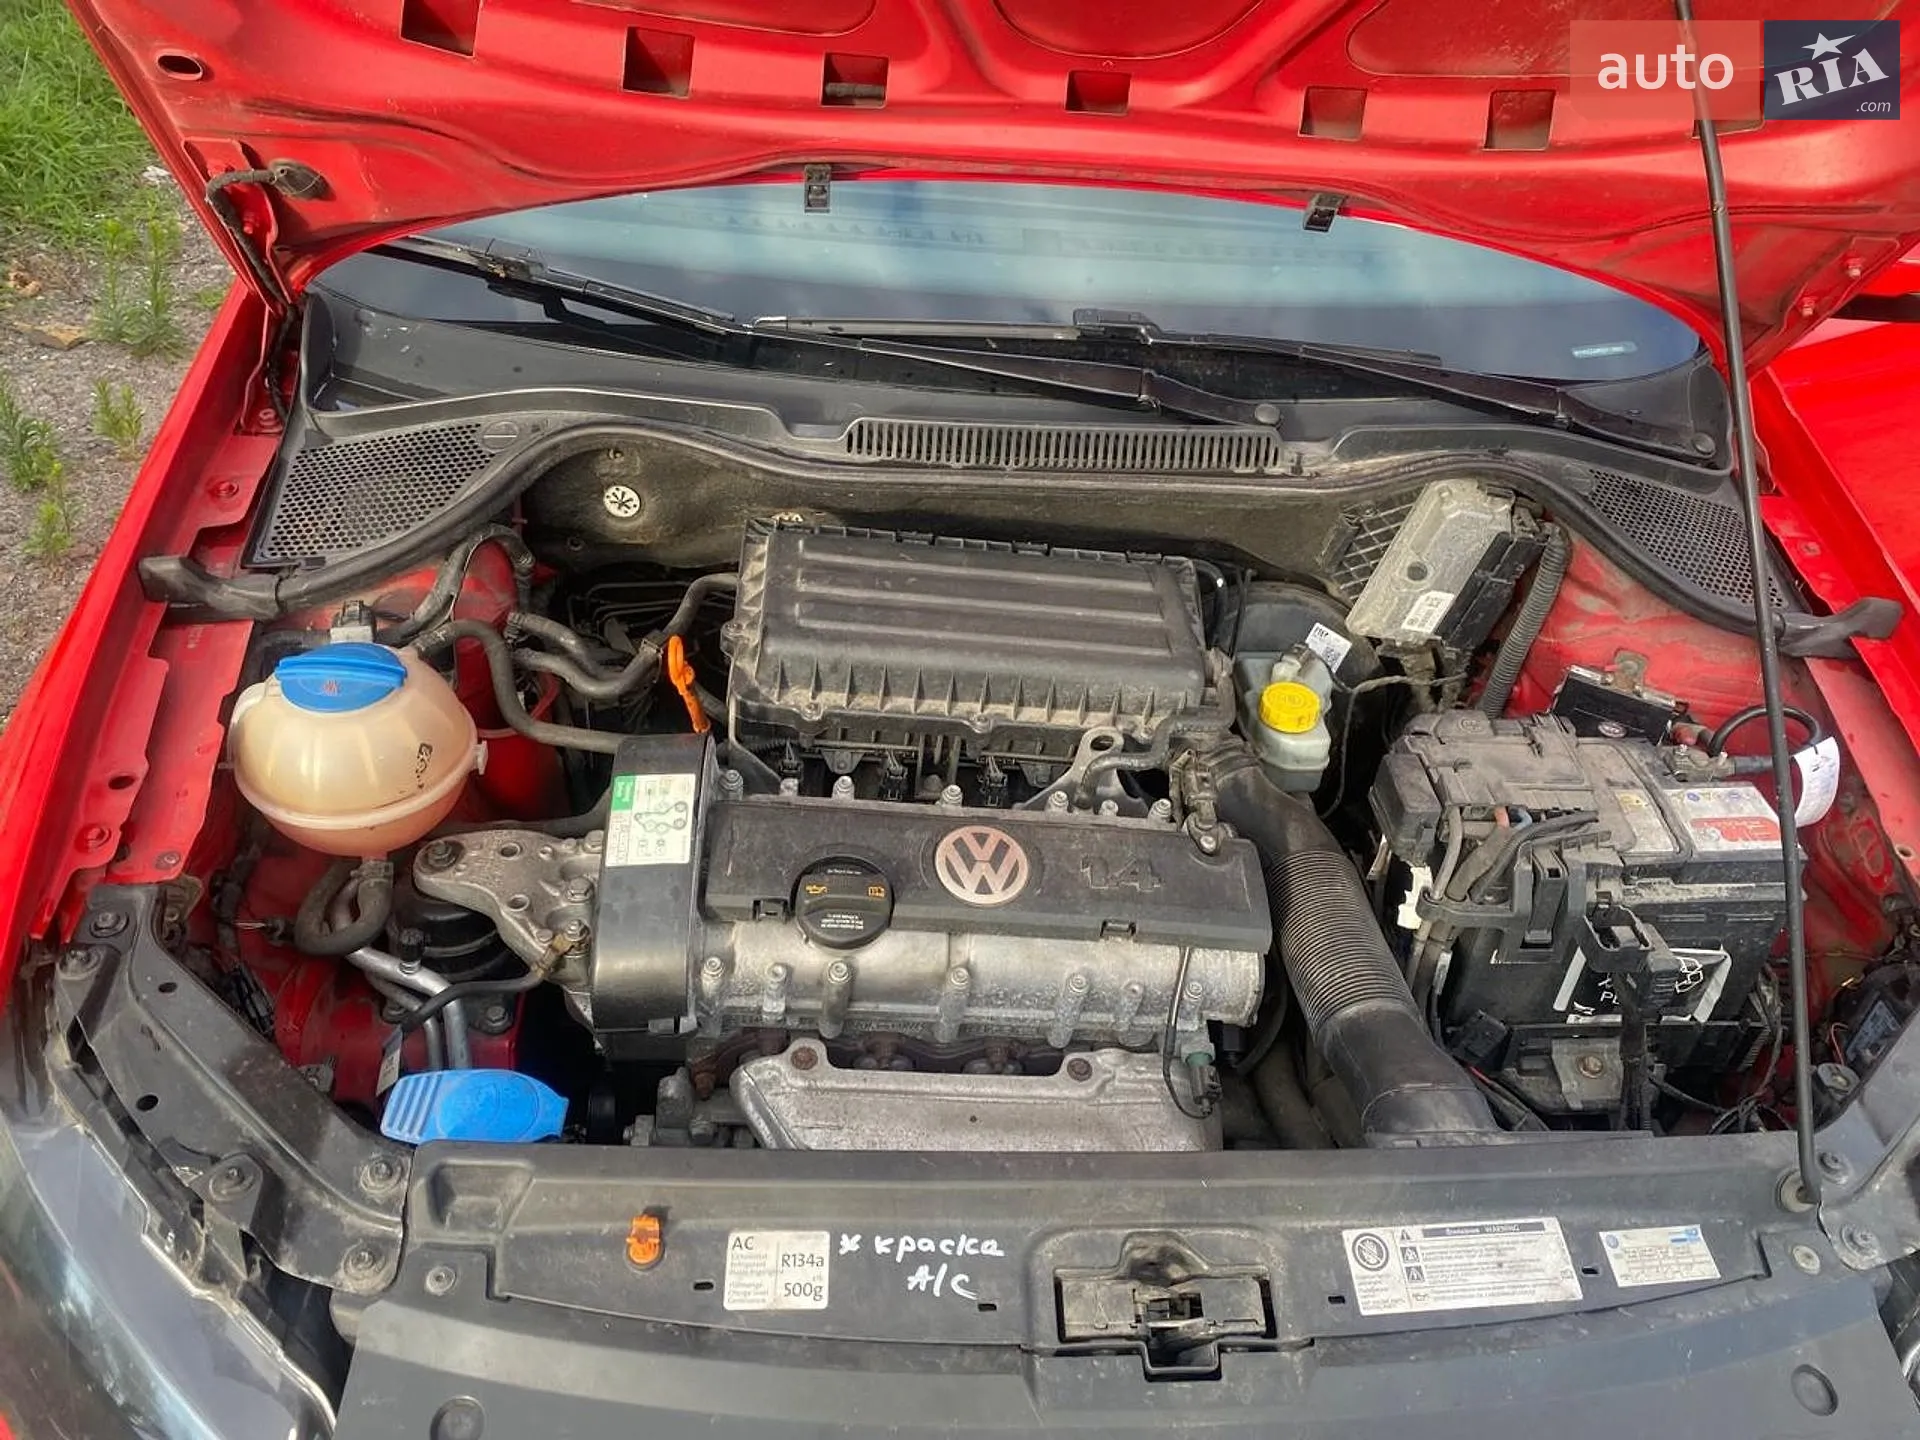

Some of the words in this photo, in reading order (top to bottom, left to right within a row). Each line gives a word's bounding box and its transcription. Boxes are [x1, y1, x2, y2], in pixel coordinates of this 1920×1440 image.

[935, 825, 1029, 905] VW
[731, 1235, 755, 1251] AC
[781, 1252, 825, 1268] R134a
[783, 1281, 824, 1302] 500g
